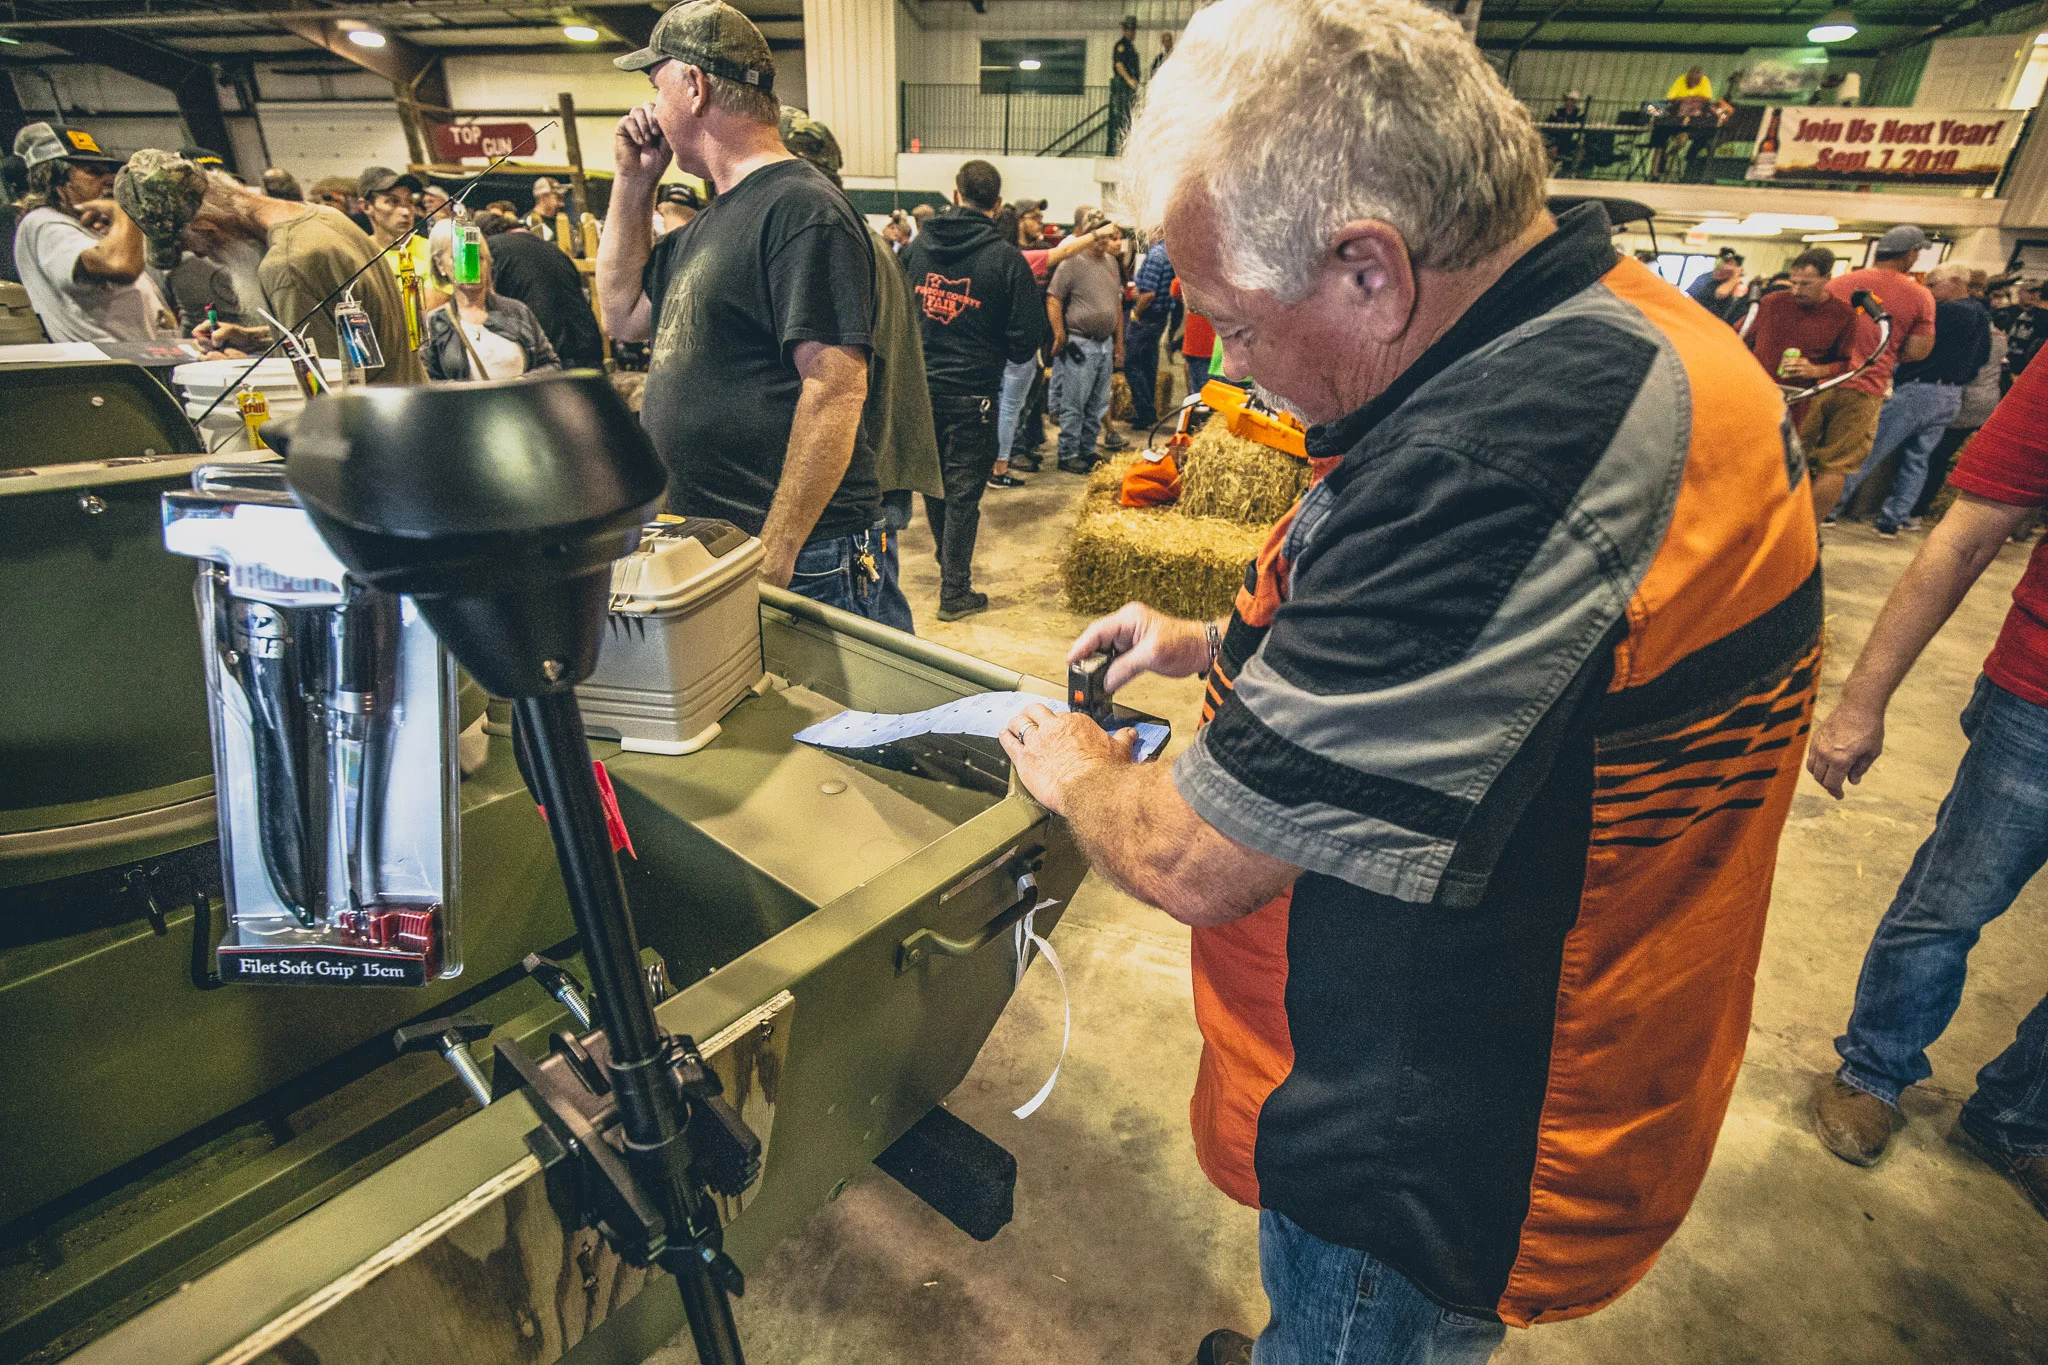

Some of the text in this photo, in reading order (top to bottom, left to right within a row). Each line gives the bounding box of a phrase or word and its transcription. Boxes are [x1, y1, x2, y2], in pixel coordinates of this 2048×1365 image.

[449, 127, 481, 144] TOP
[1794, 118, 2005, 146] Join Us Next Year!
[482, 137, 513, 155] GUN
[1899, 149, 1960, 173] 2019
[927, 295, 957, 311] FAIR
[239, 958, 278, 974] Filet
[279, 959, 314, 975] Soft
[362, 963, 405, 978] 15cm
